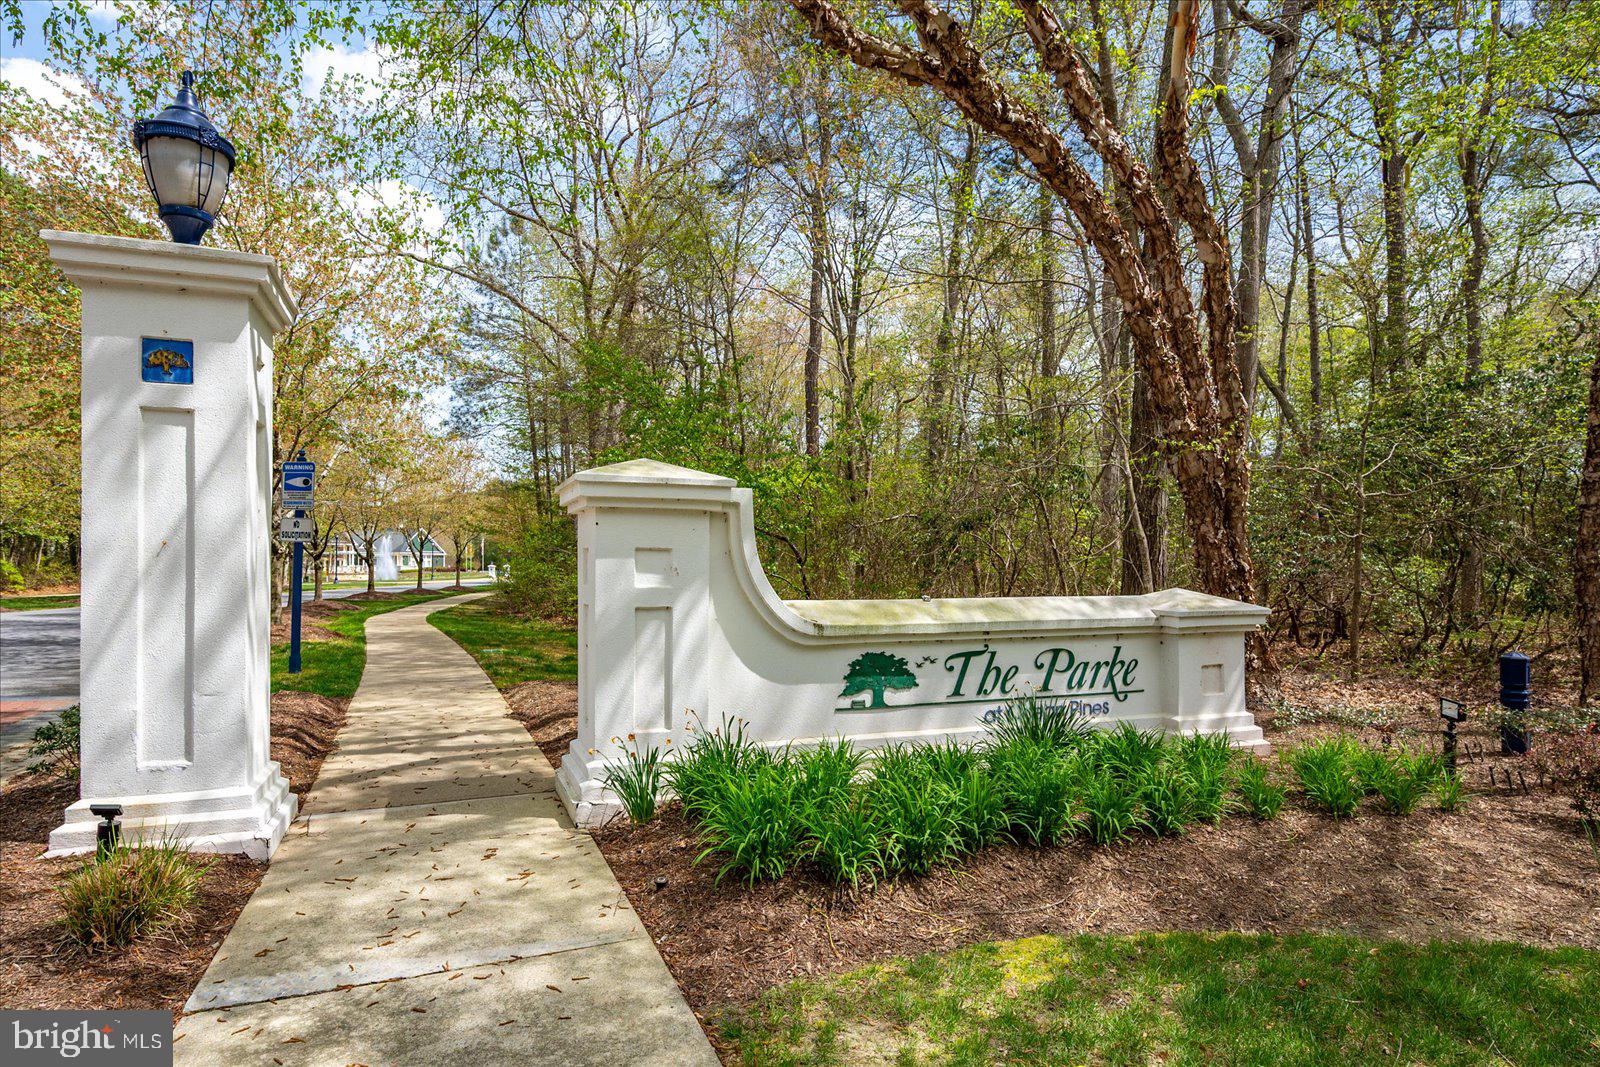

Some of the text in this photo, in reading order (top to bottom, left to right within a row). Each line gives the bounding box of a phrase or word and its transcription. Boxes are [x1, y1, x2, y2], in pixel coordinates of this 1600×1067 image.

[293, 520, 300, 528] NO
[281, 530, 312, 539] SOLICITATION
[944, 644, 1139, 702] The Parke
[1070, 700, 1110, 717] Pines
